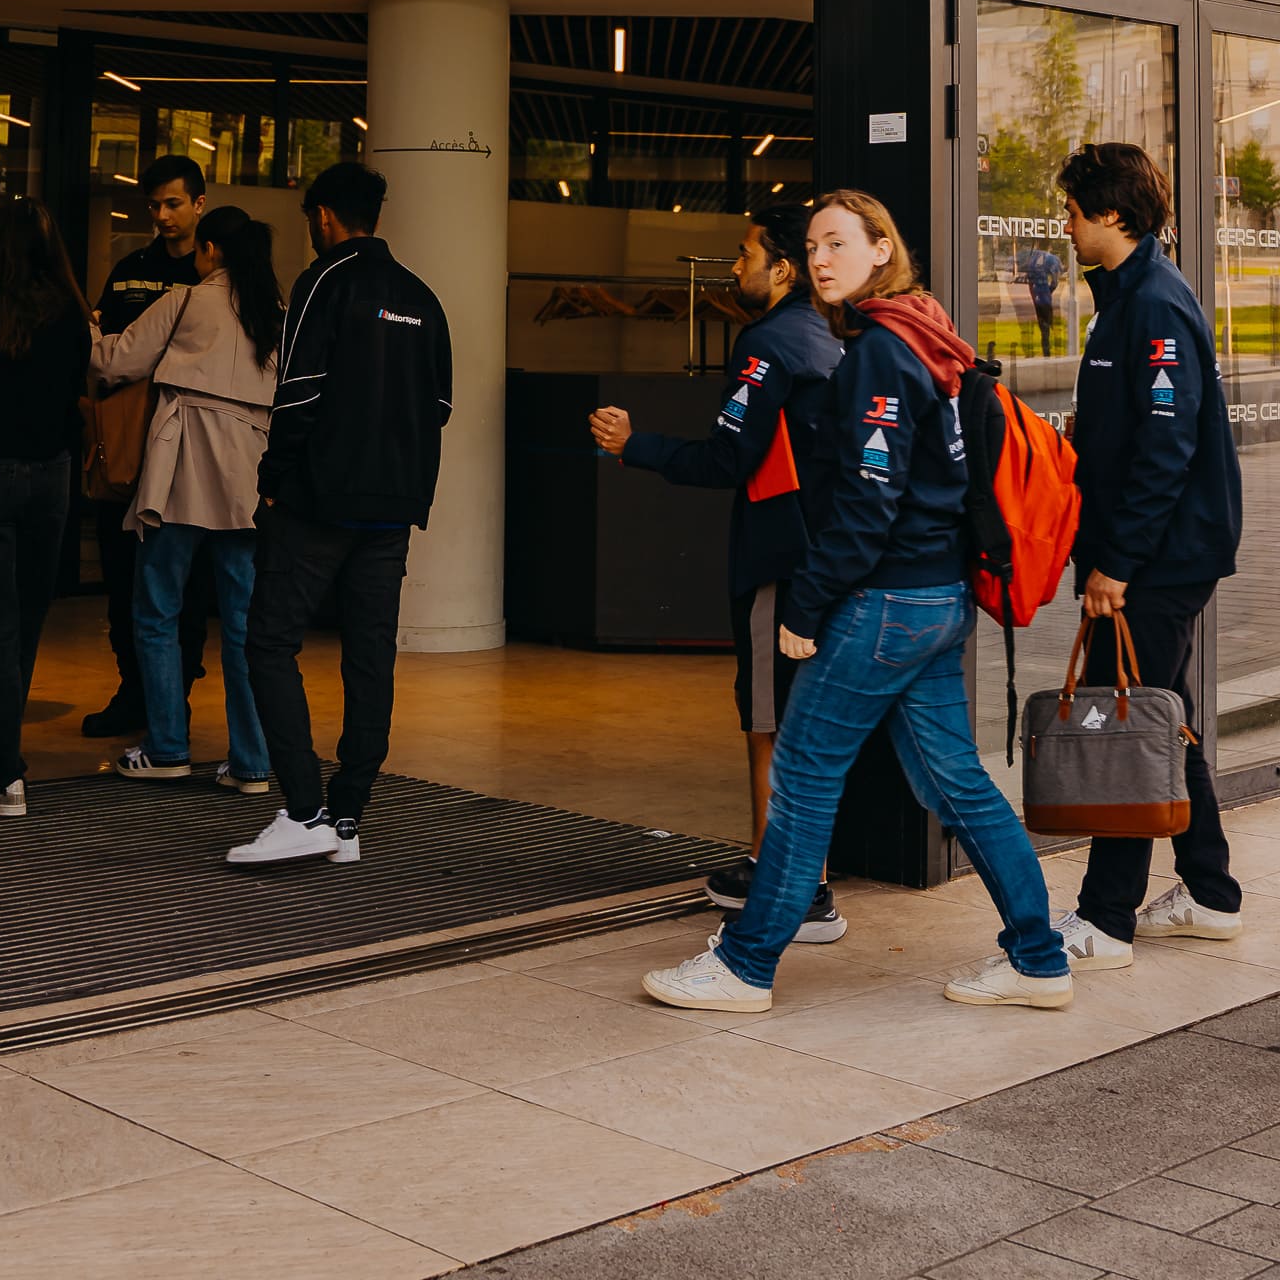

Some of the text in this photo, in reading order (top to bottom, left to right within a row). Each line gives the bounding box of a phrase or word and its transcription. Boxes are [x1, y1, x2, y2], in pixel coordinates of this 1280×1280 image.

[430, 139, 465, 151] Accès
[977, 215, 1045, 237] CENTRE
[1216, 227, 1255, 247] GERS
[1149, 338, 1177, 361] JE
[740, 355, 771, 382] JE
[865, 395, 900, 421] JE
